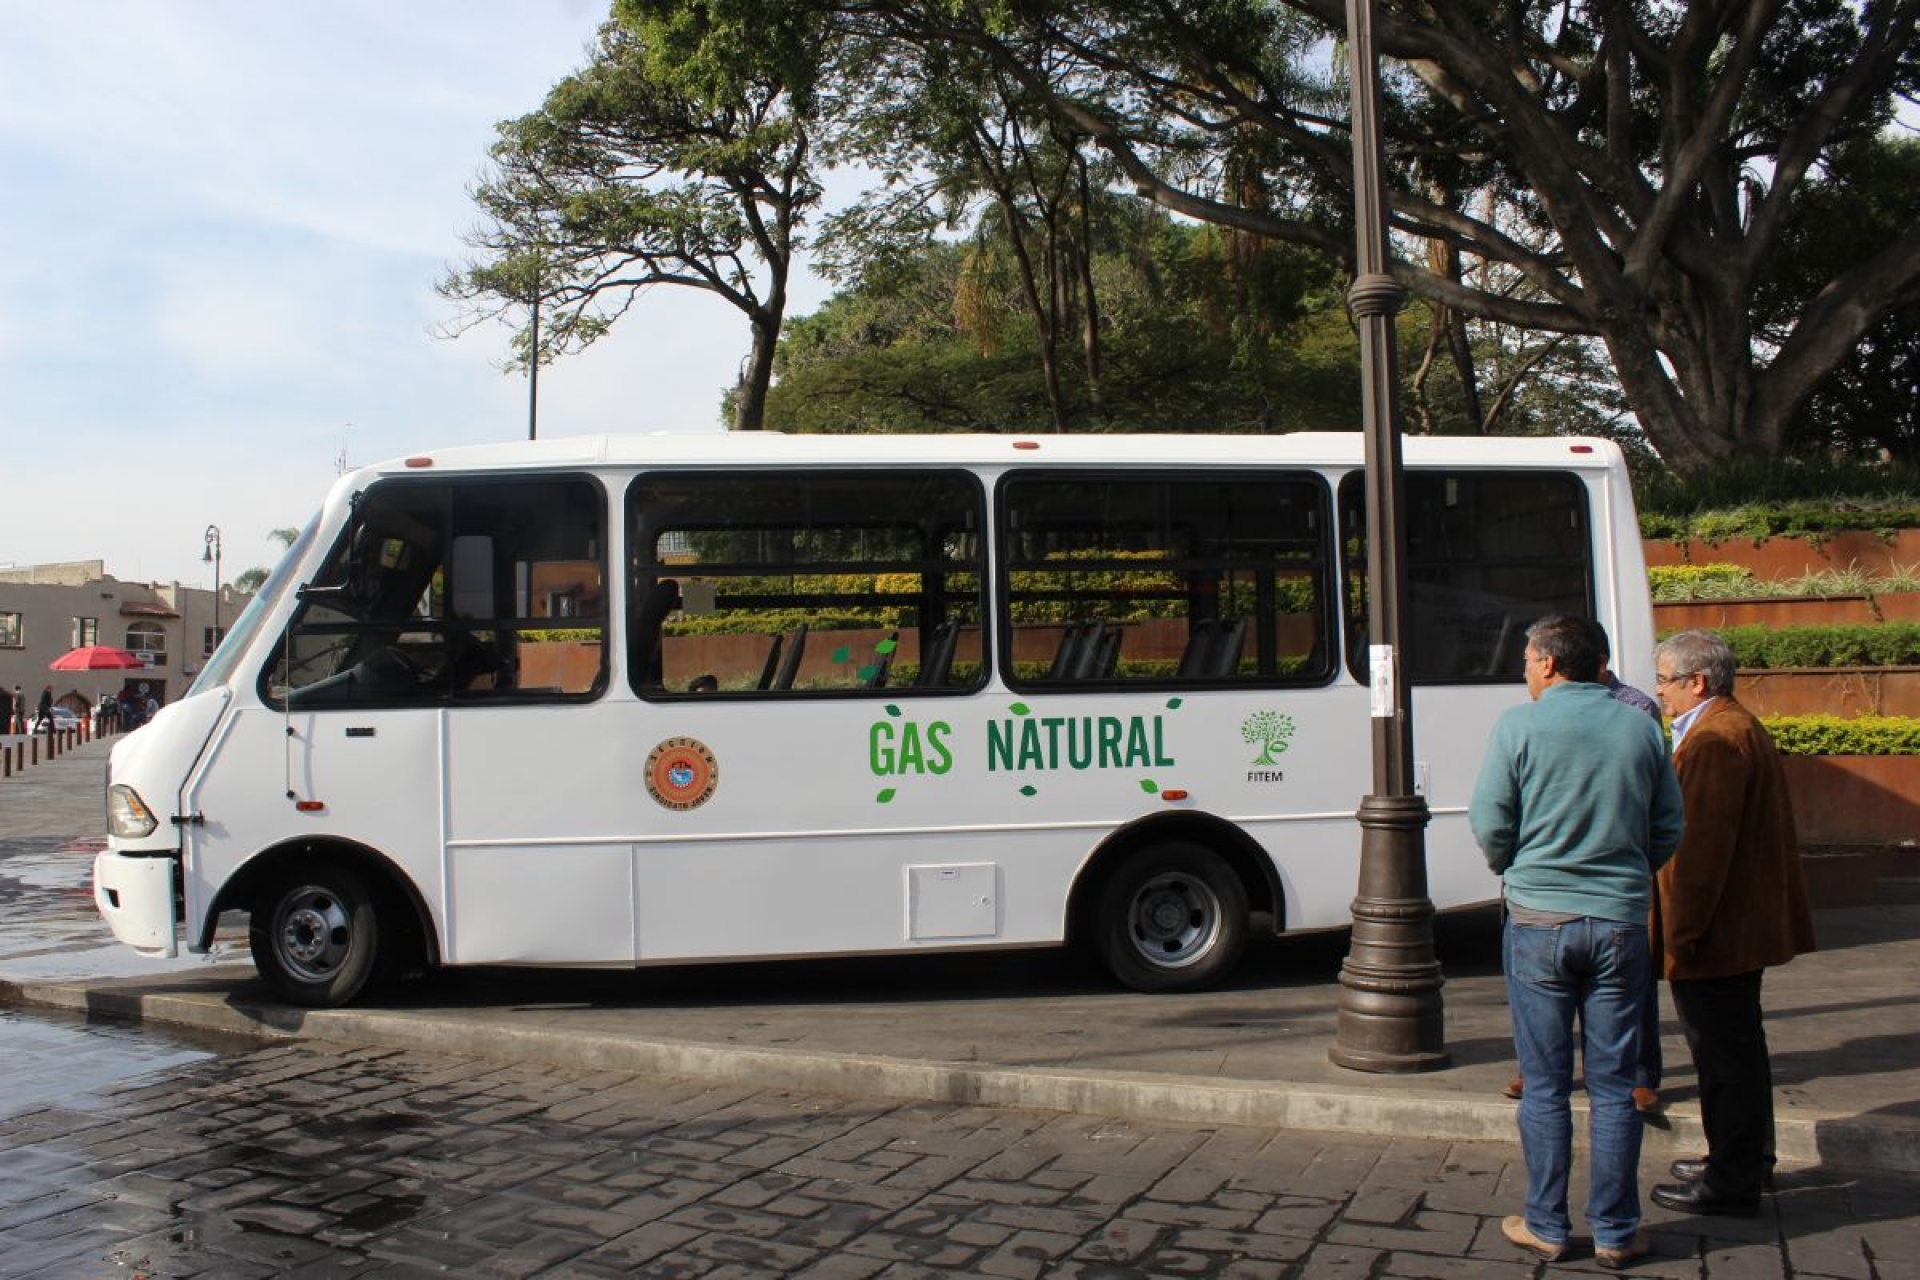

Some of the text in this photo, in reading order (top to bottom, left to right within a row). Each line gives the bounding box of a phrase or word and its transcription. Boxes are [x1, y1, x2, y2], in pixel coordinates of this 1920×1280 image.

[869, 715, 1175, 777] GAS NATURAL
[1247, 771, 1283, 782] FITEM
